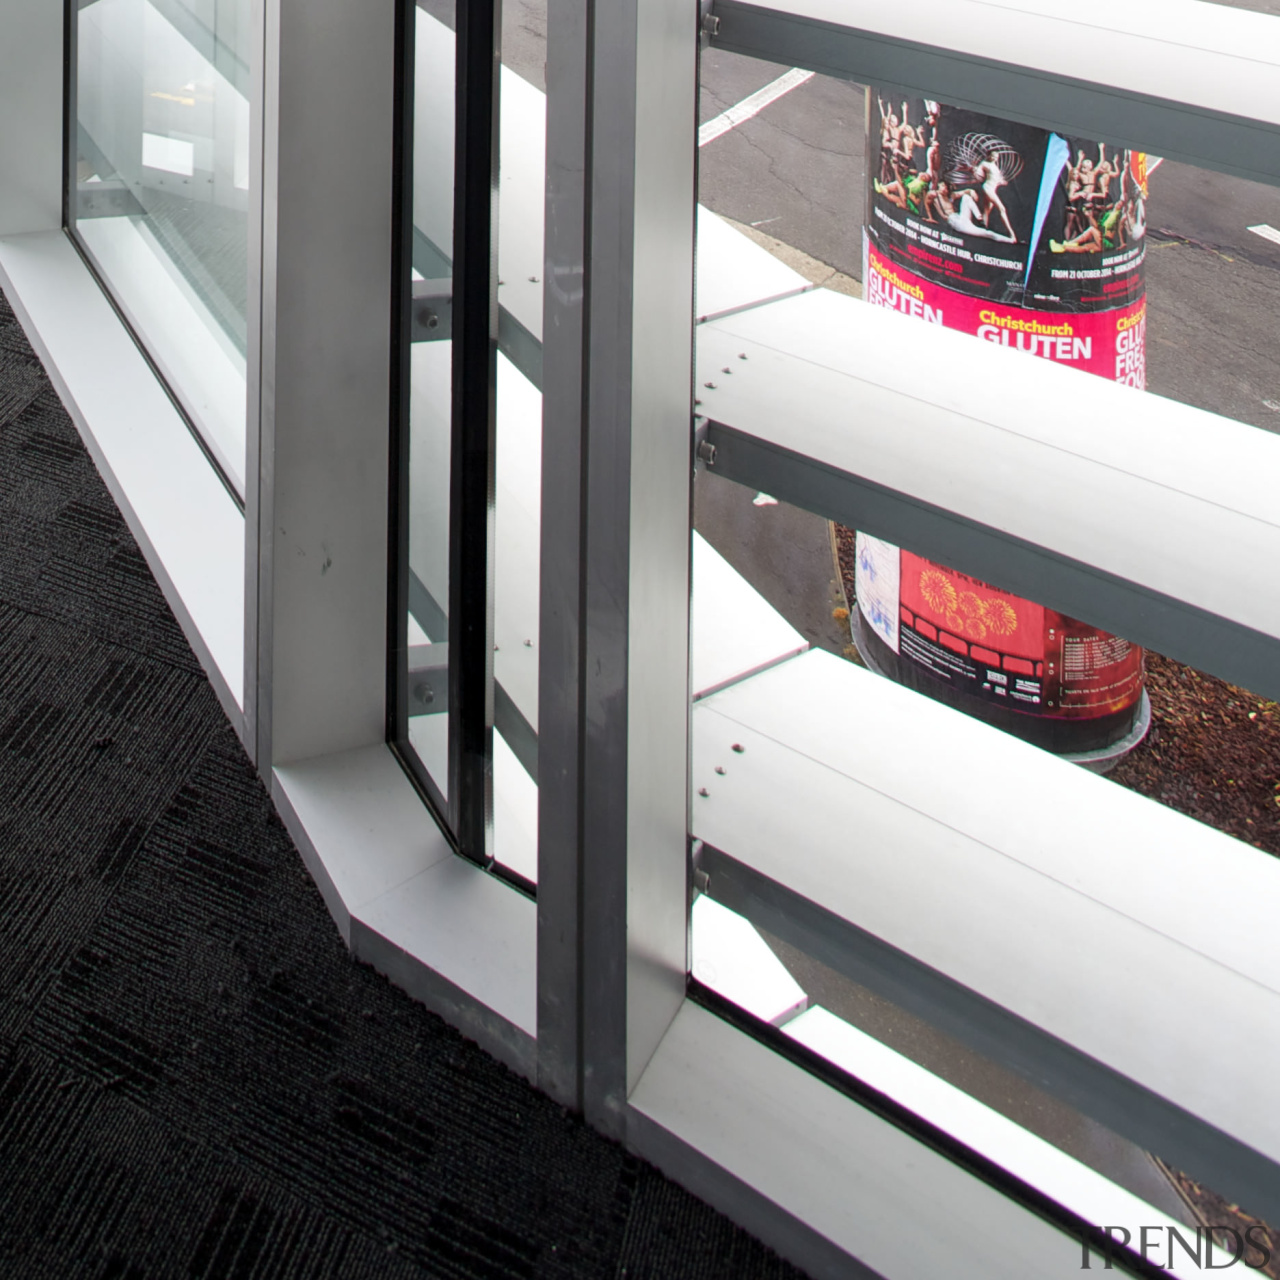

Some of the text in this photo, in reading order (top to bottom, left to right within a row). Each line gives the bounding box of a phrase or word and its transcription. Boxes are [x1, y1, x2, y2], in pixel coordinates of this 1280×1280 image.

[869, 254, 924, 300] Christchurch
[974, 253, 1023, 270] CHRISTCHURCH
[1051, 269, 1068, 279] FROM
[1069, 269, 1076, 279] 21
[1076, 269, 1100, 279] OCTOBER
[869, 267, 943, 326] GLUTEN
[979, 309, 1073, 336] Christchurch
[977, 324, 1092, 360] GLUTEN
